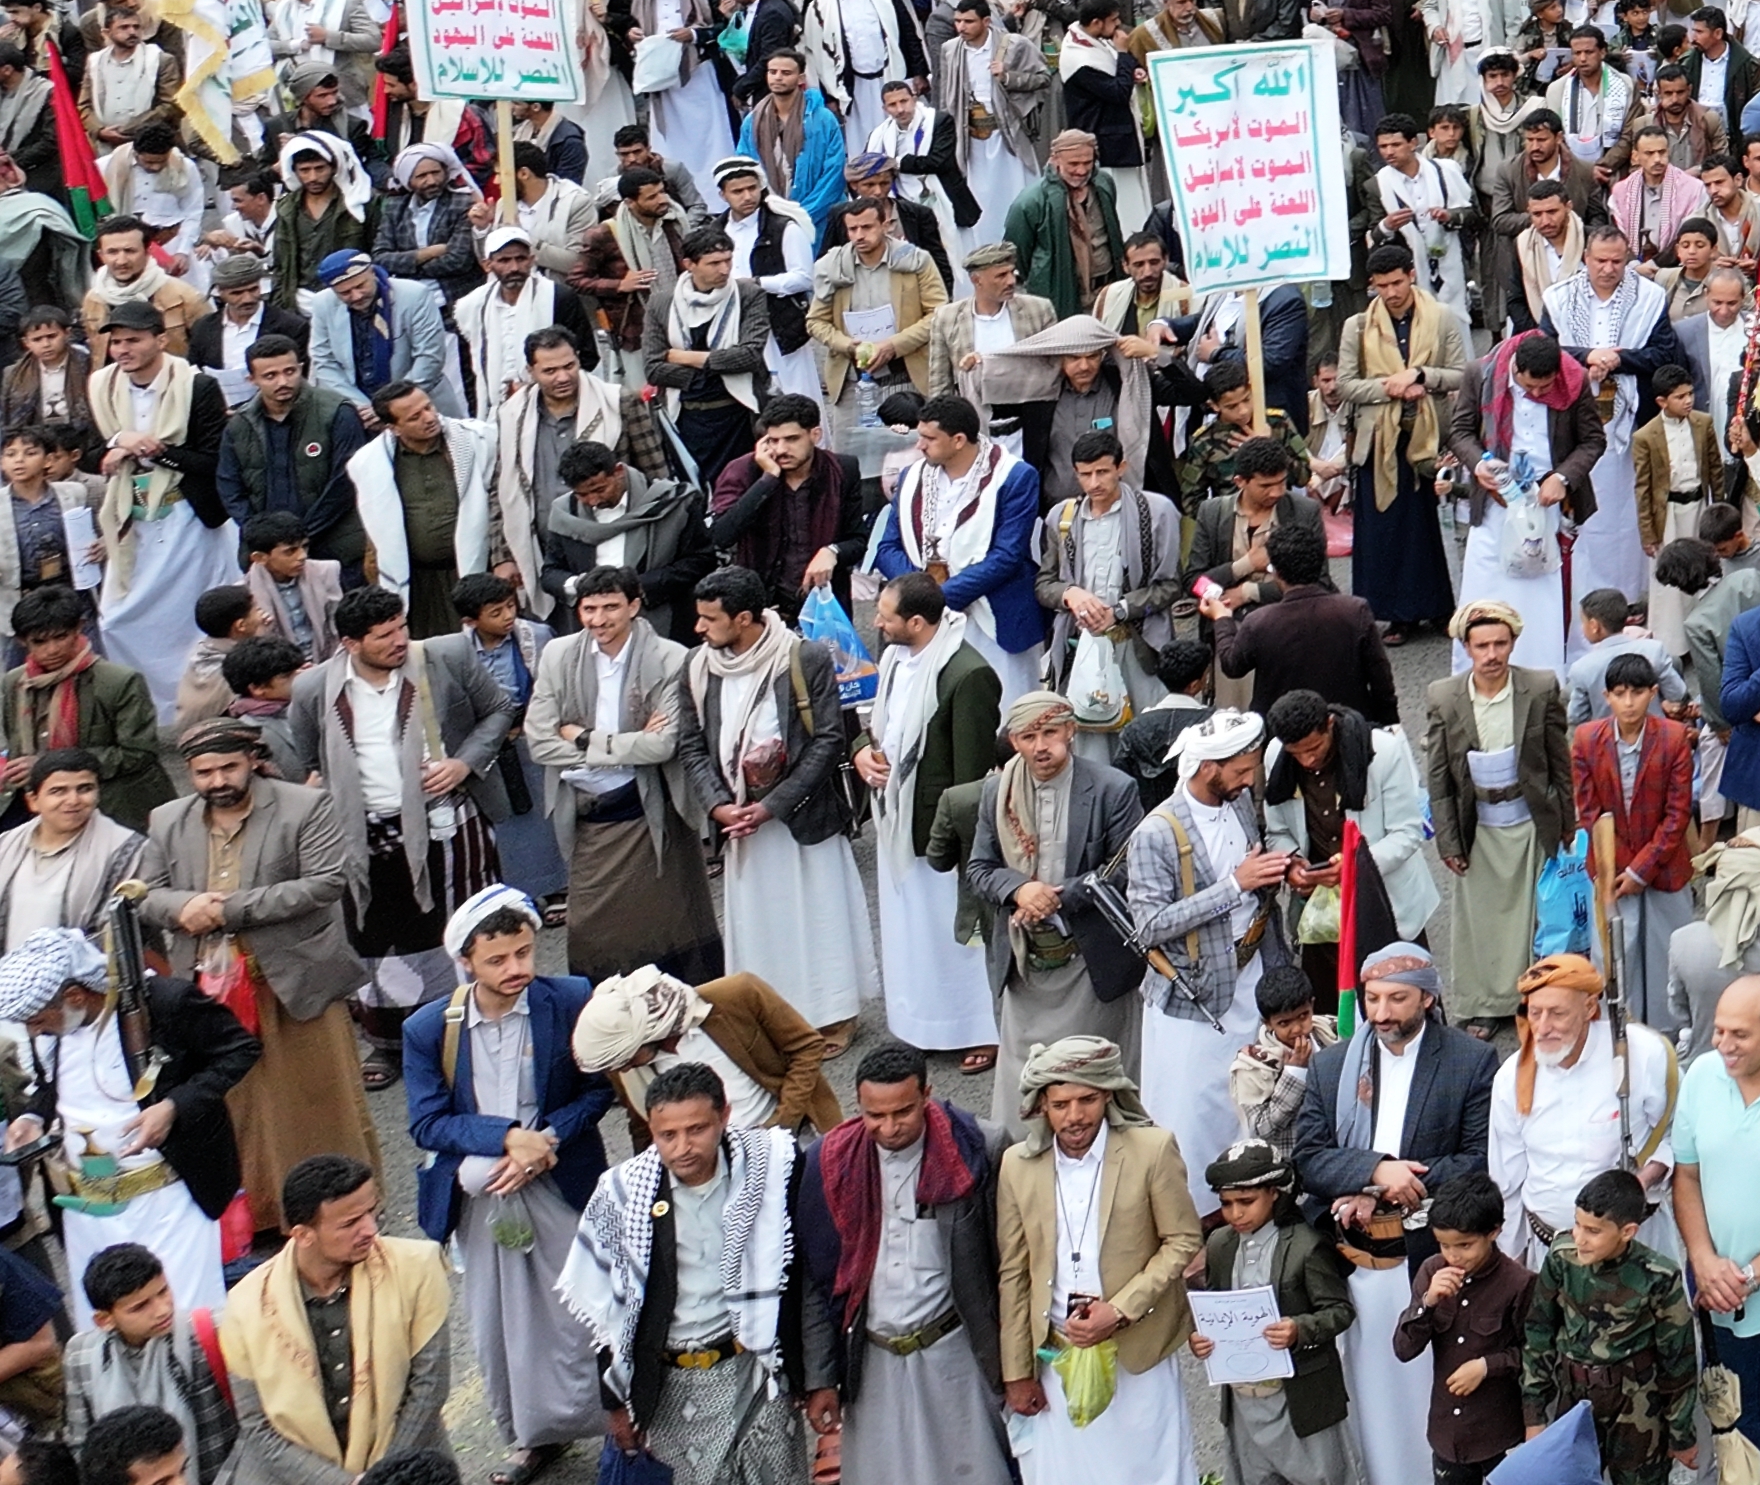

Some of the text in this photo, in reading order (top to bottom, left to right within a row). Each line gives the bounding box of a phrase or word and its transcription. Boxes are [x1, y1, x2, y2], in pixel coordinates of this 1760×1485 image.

[433, 25, 560, 52] اللعنة على اليهود
[437, 56, 569, 92] النصر للإسلام
[1168, 58, 1306, 117] الله أكبر
[1248, 111, 1308, 142] الموت
[1252, 150, 1312, 182] الموت
[1234, 194, 1262, 226] على
[1271, 189, 1316, 215] اللعنة
[1258, 224, 1319, 271] النصر
